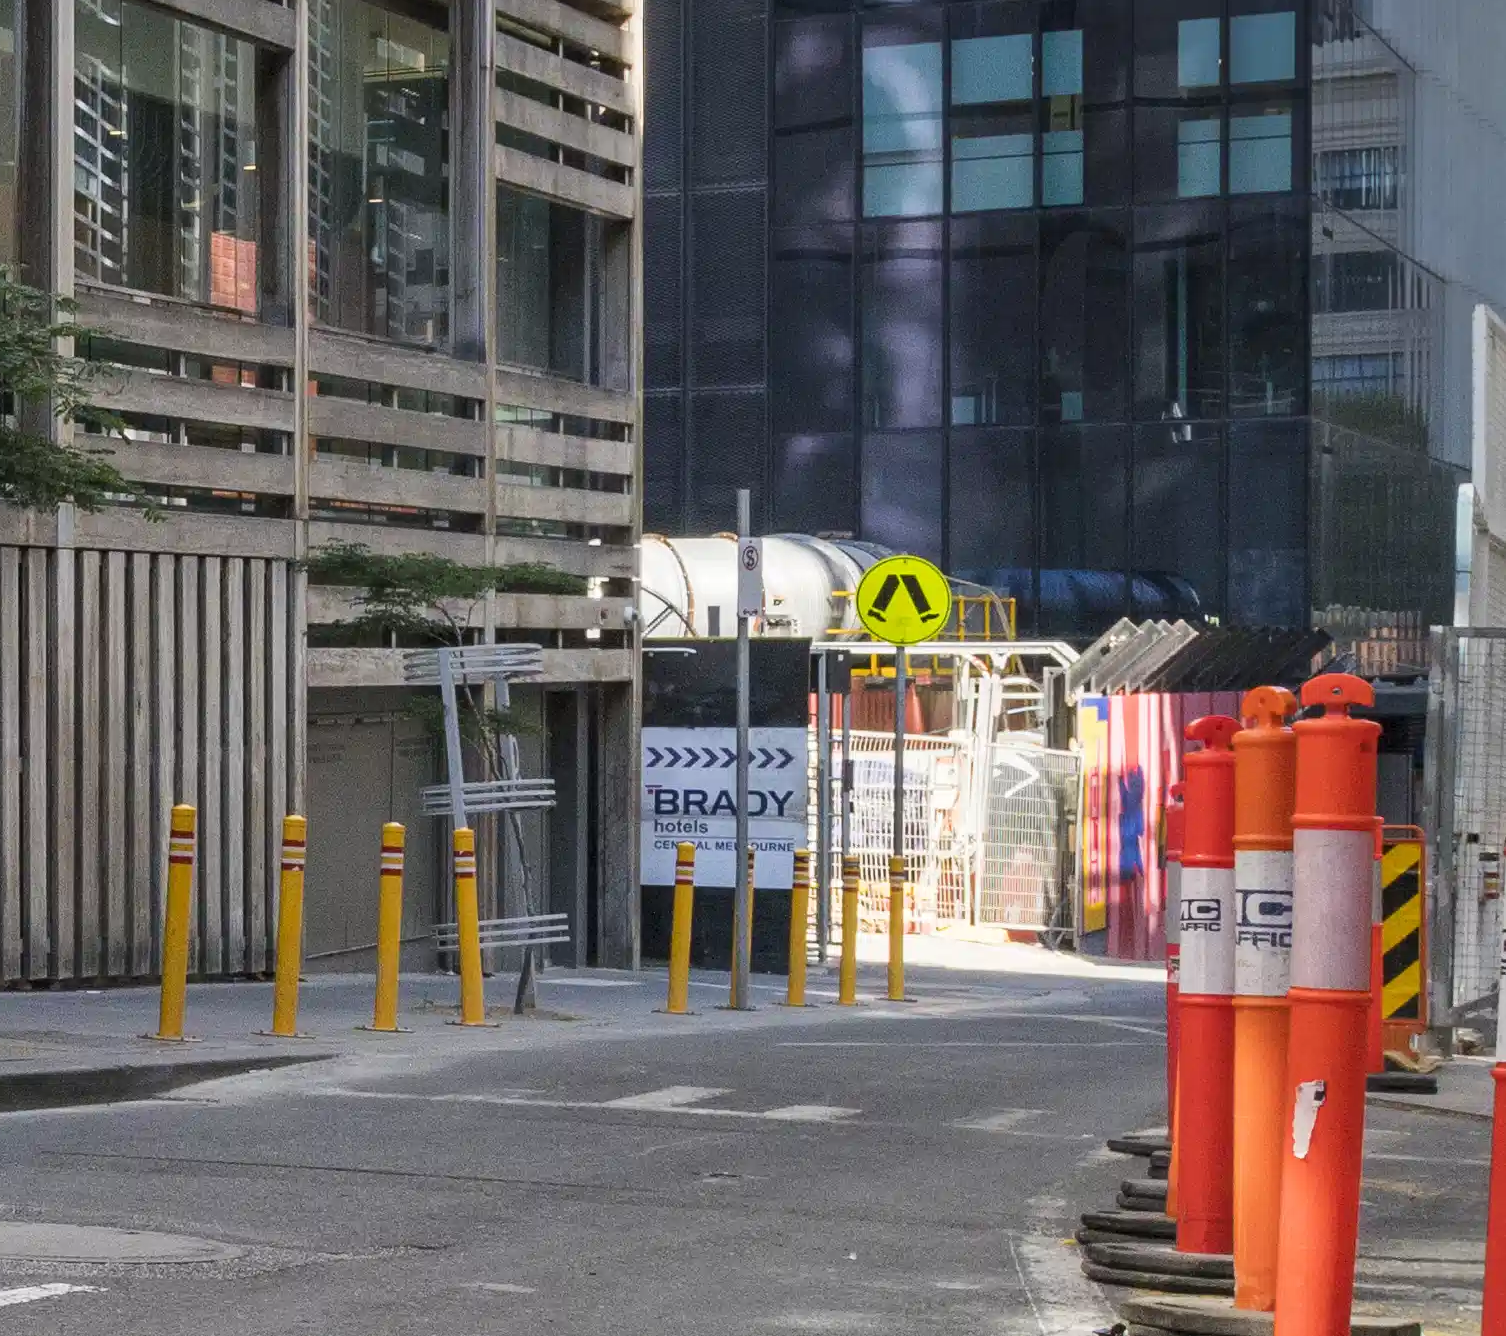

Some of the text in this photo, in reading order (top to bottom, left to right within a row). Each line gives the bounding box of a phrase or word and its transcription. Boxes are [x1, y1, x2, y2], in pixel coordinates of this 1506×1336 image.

[653, 788, 795, 817] BRADY
[653, 818, 709, 834] hotels
[654, 839, 794, 852] CENAL MELOURNE
